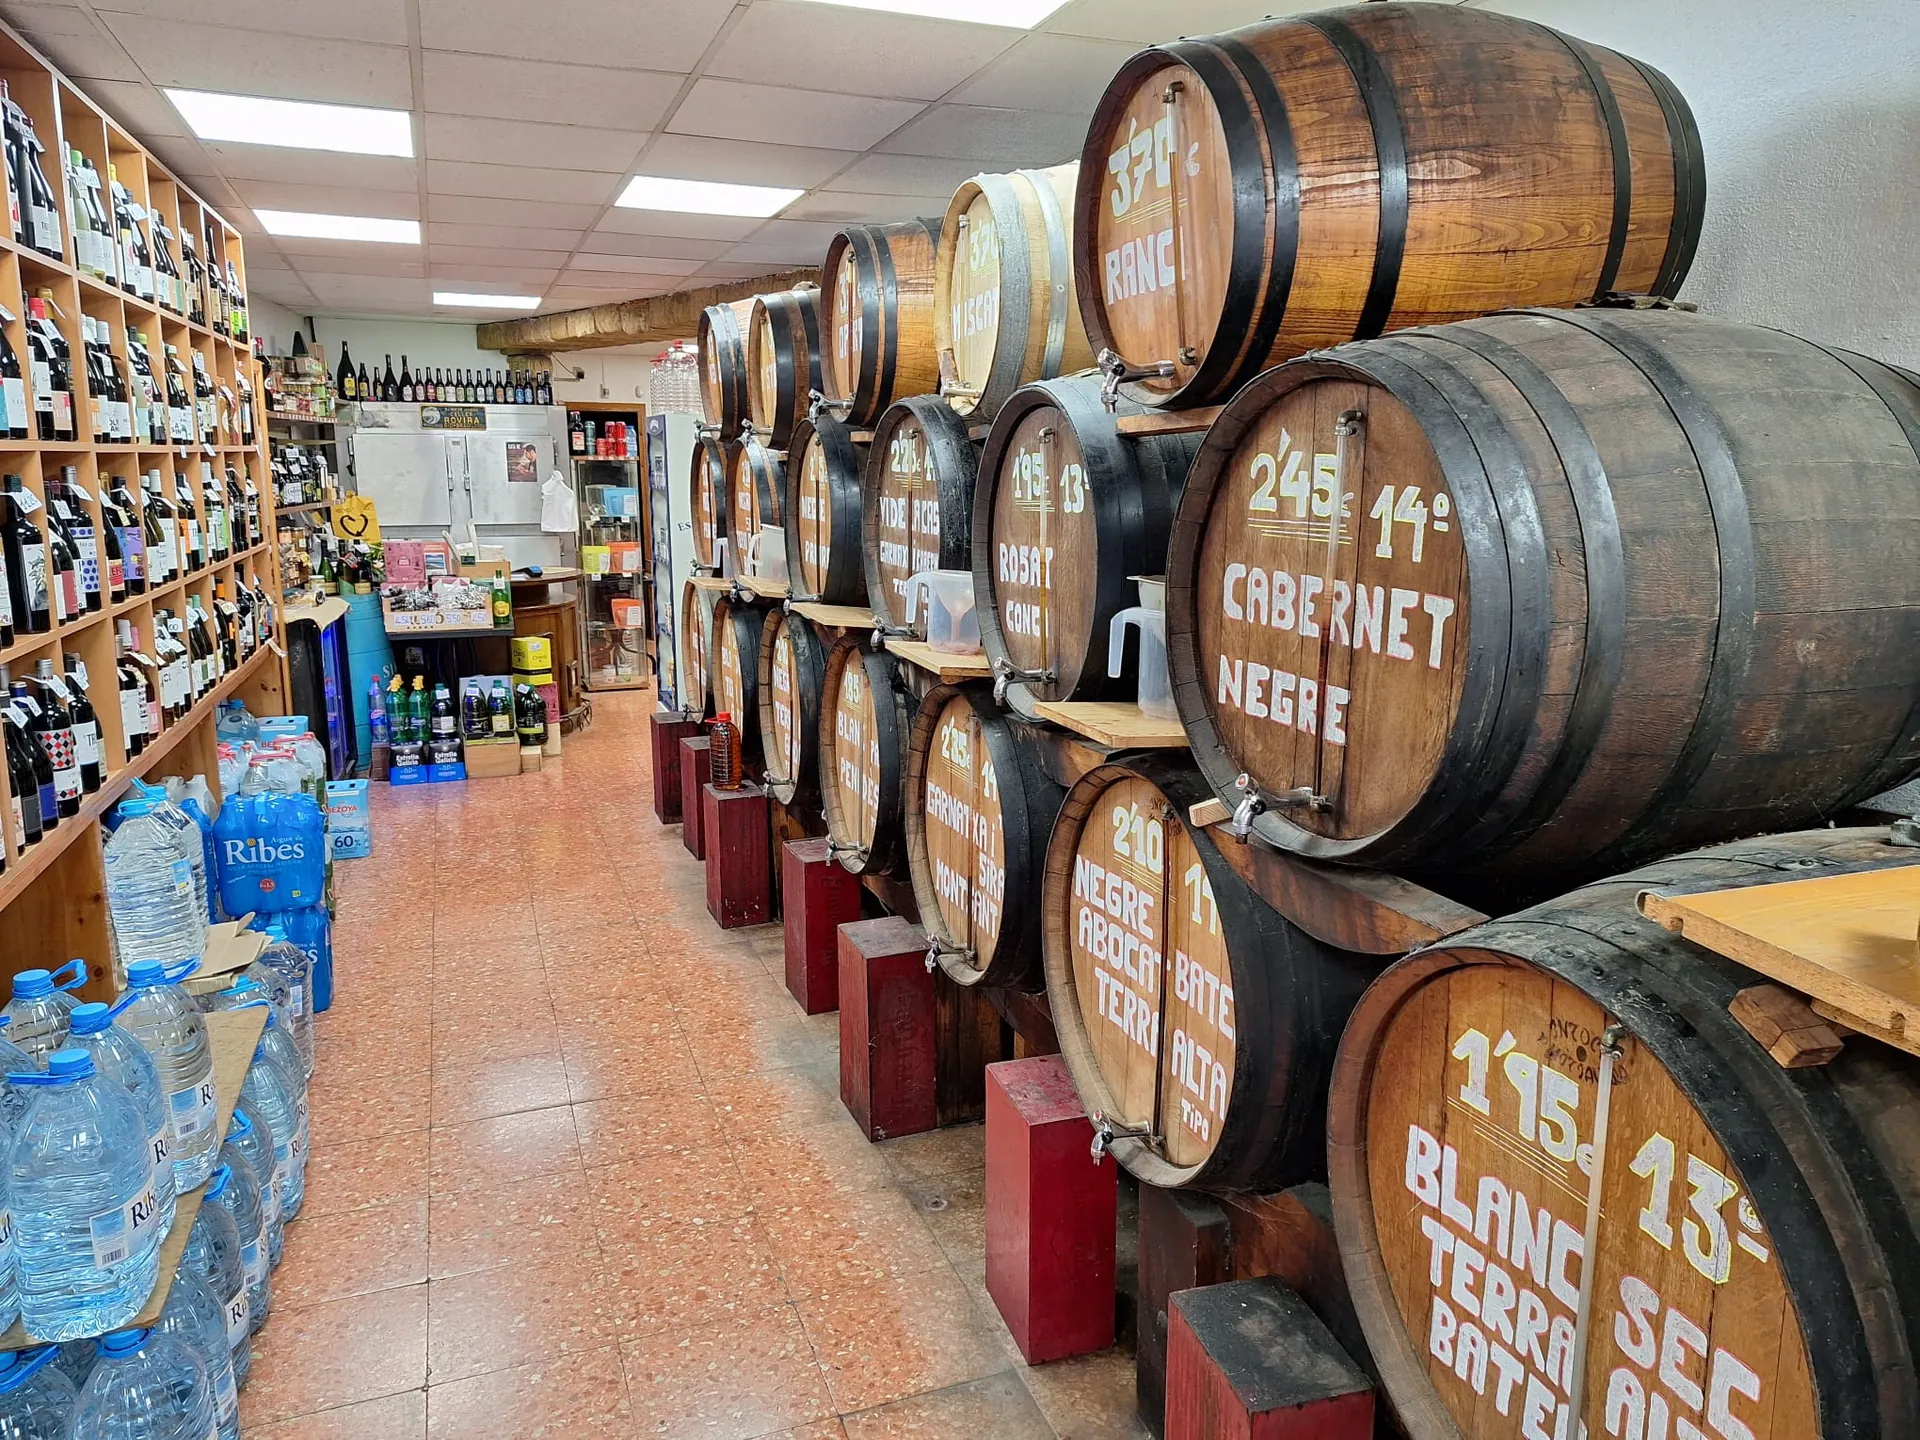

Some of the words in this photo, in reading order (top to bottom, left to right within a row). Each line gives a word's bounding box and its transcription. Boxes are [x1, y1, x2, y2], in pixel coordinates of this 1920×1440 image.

[1223, 563, 1455, 669] CABERNET
[838, 711, 866, 751] BLAN
[1218, 655, 1352, 747] NEGRE
[223, 837, 305, 866] Ribes
[1075, 854, 1155, 941] NEGRE
[1171, 1028, 1227, 1123] ALTA
[1405, 1124, 1587, 1314] BLANC
[1421, 1215, 1577, 1395] TERRA
